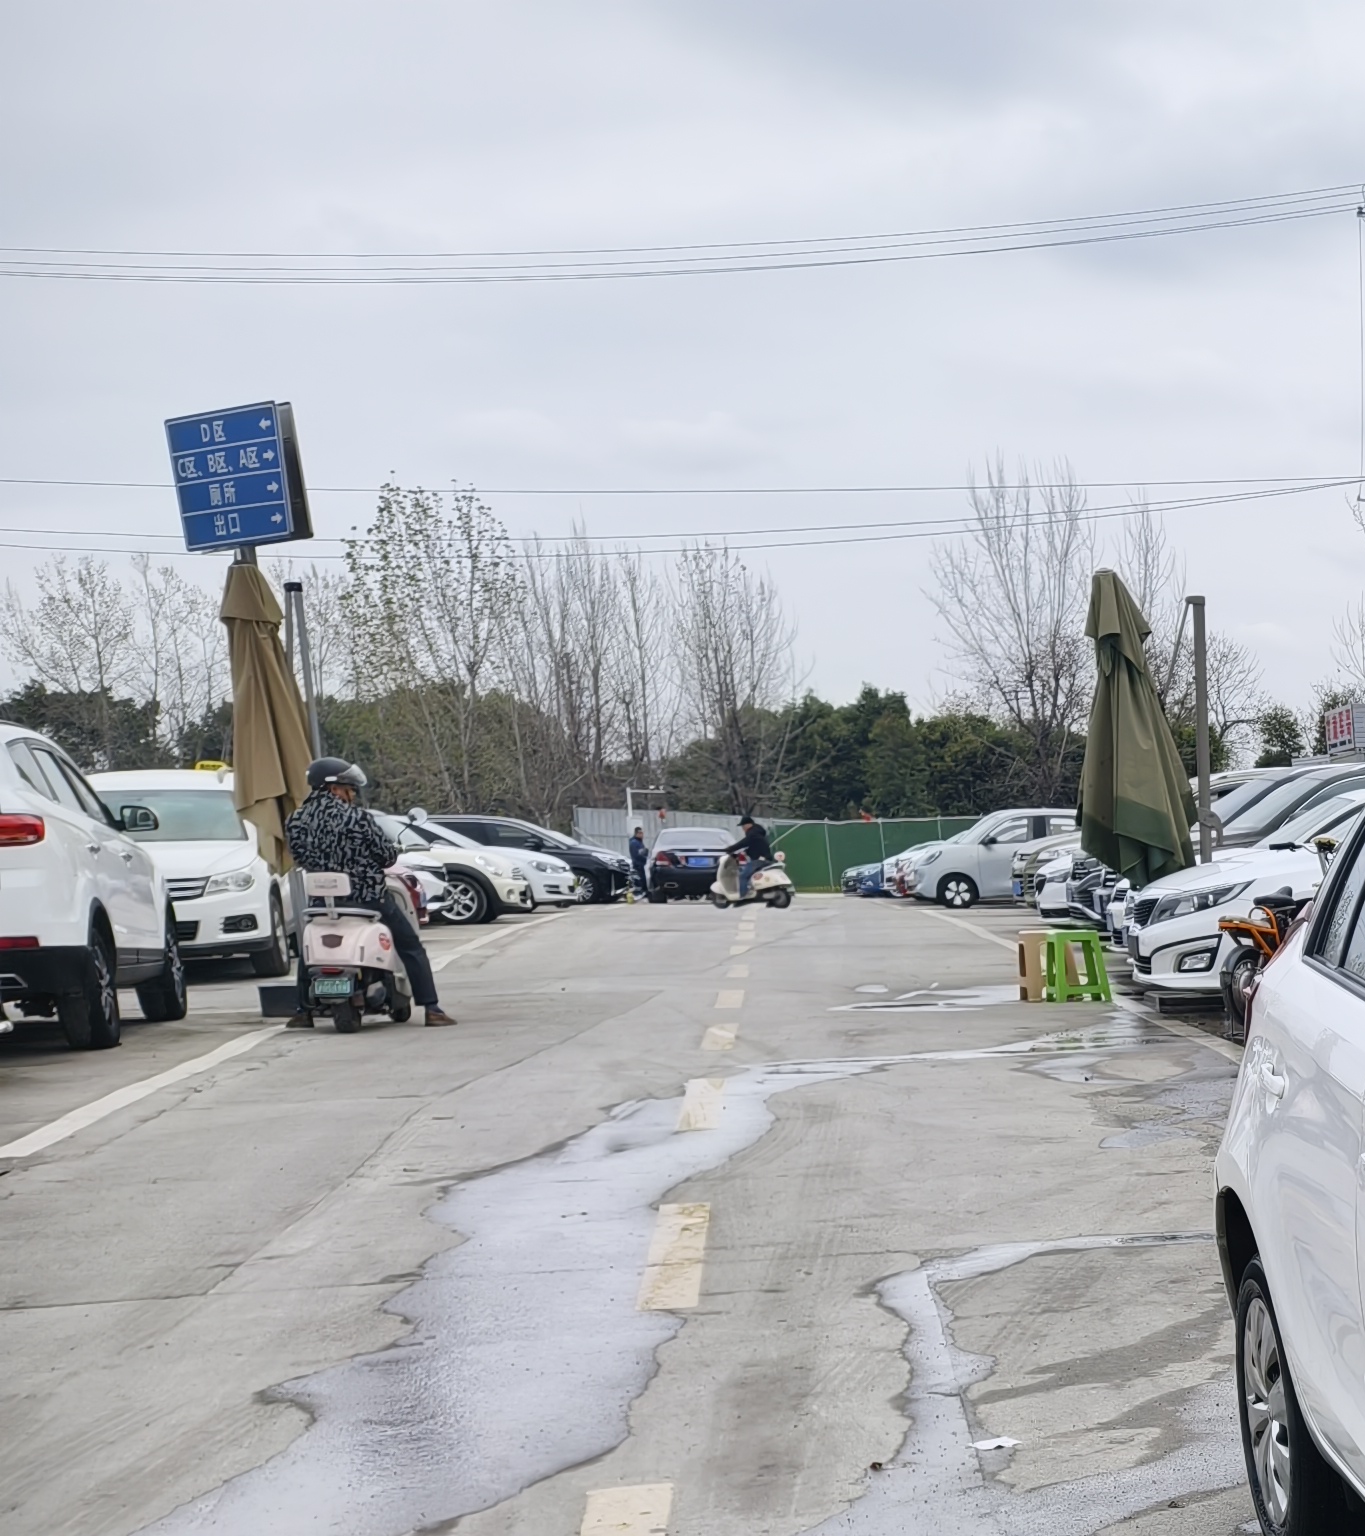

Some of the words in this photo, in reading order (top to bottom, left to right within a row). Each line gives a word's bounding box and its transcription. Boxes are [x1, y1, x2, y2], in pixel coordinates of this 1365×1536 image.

[200, 420, 226, 442] D区
[208, 480, 236, 506] 厕所
[213, 512, 241, 536] 出口
